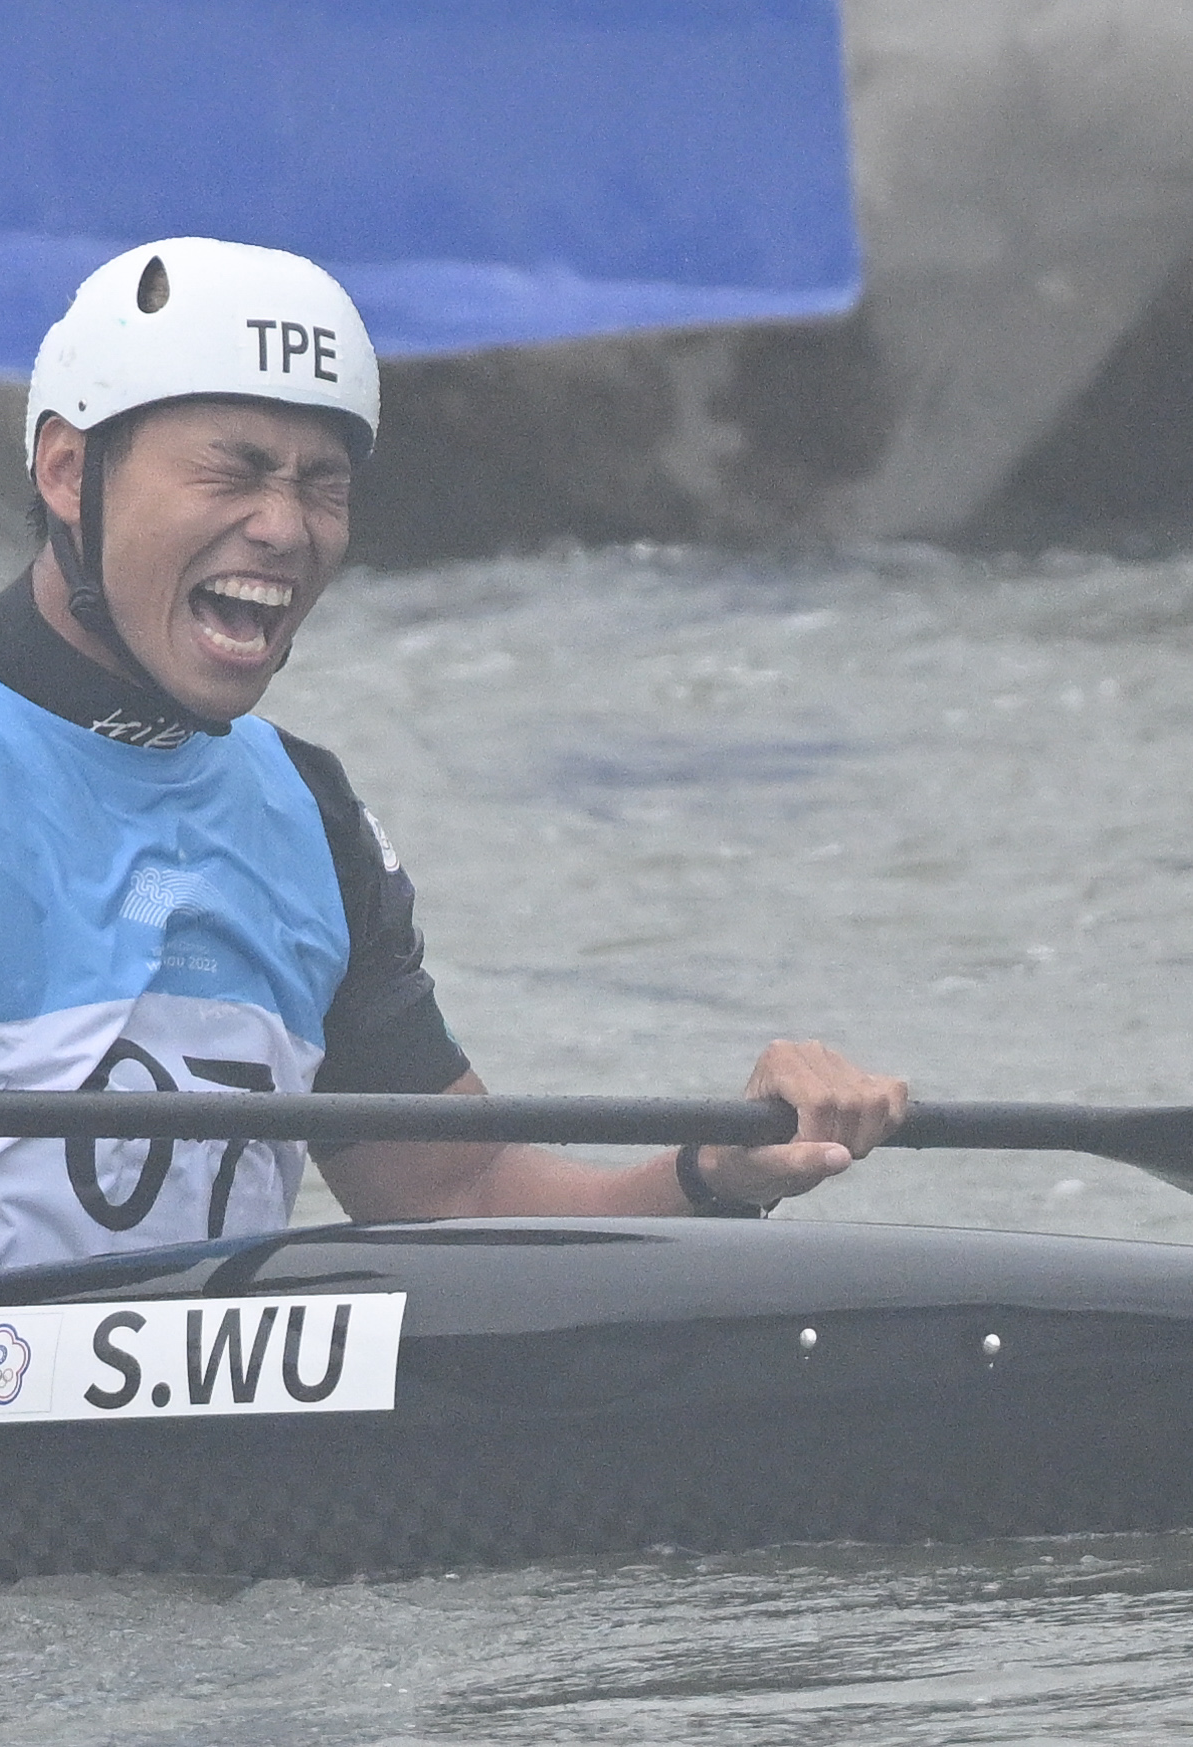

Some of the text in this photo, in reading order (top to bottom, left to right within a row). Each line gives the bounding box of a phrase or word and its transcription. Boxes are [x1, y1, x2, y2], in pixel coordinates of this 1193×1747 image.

[246, 318, 339, 384] TPE
[64, 1037, 277, 1240] 07
[83, 1303, 352, 1410] S.WU
